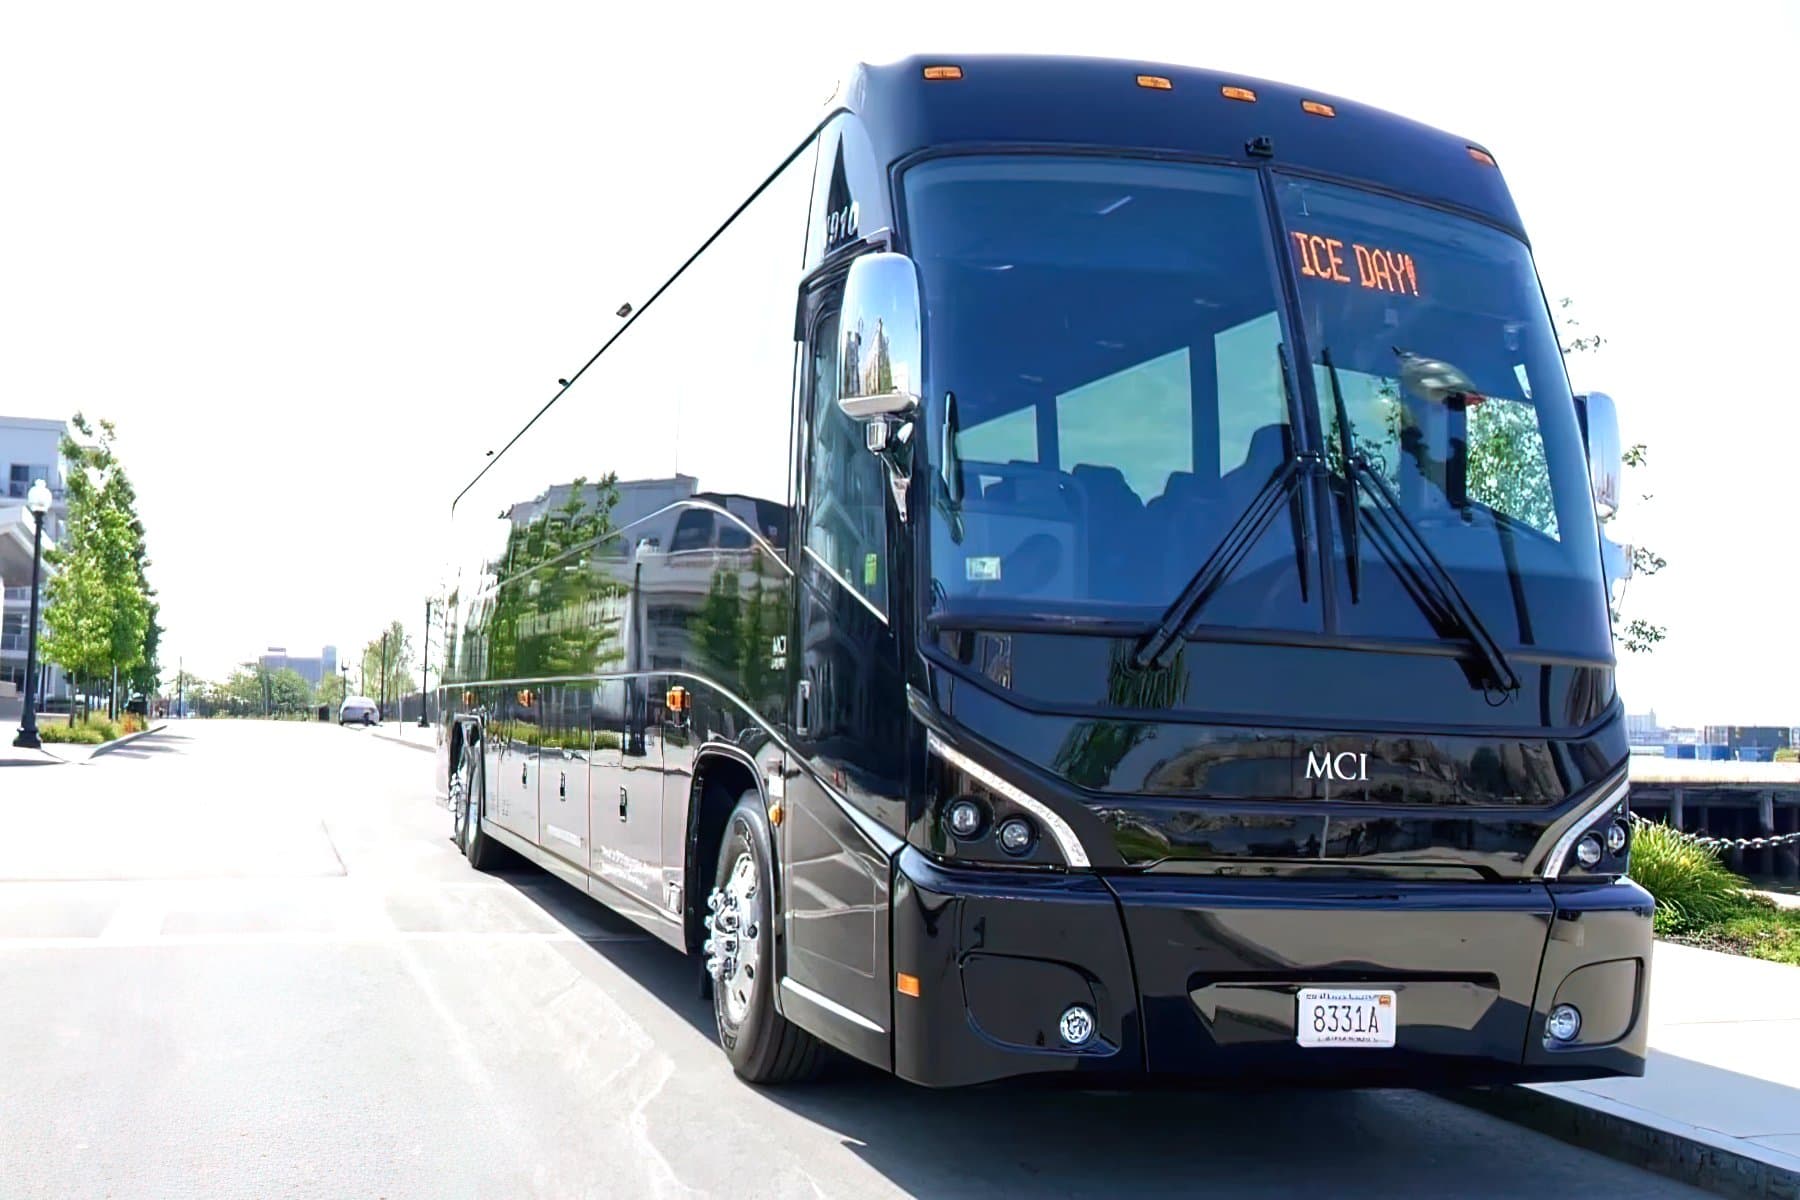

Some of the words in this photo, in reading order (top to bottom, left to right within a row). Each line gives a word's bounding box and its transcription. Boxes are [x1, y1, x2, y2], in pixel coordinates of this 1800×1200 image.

[1291, 231, 1351, 283] ICE
[1352, 244, 1419, 297] DAY!
[1304, 750, 1369, 781] MCI
[1313, 1005, 1379, 1033] 8331A
